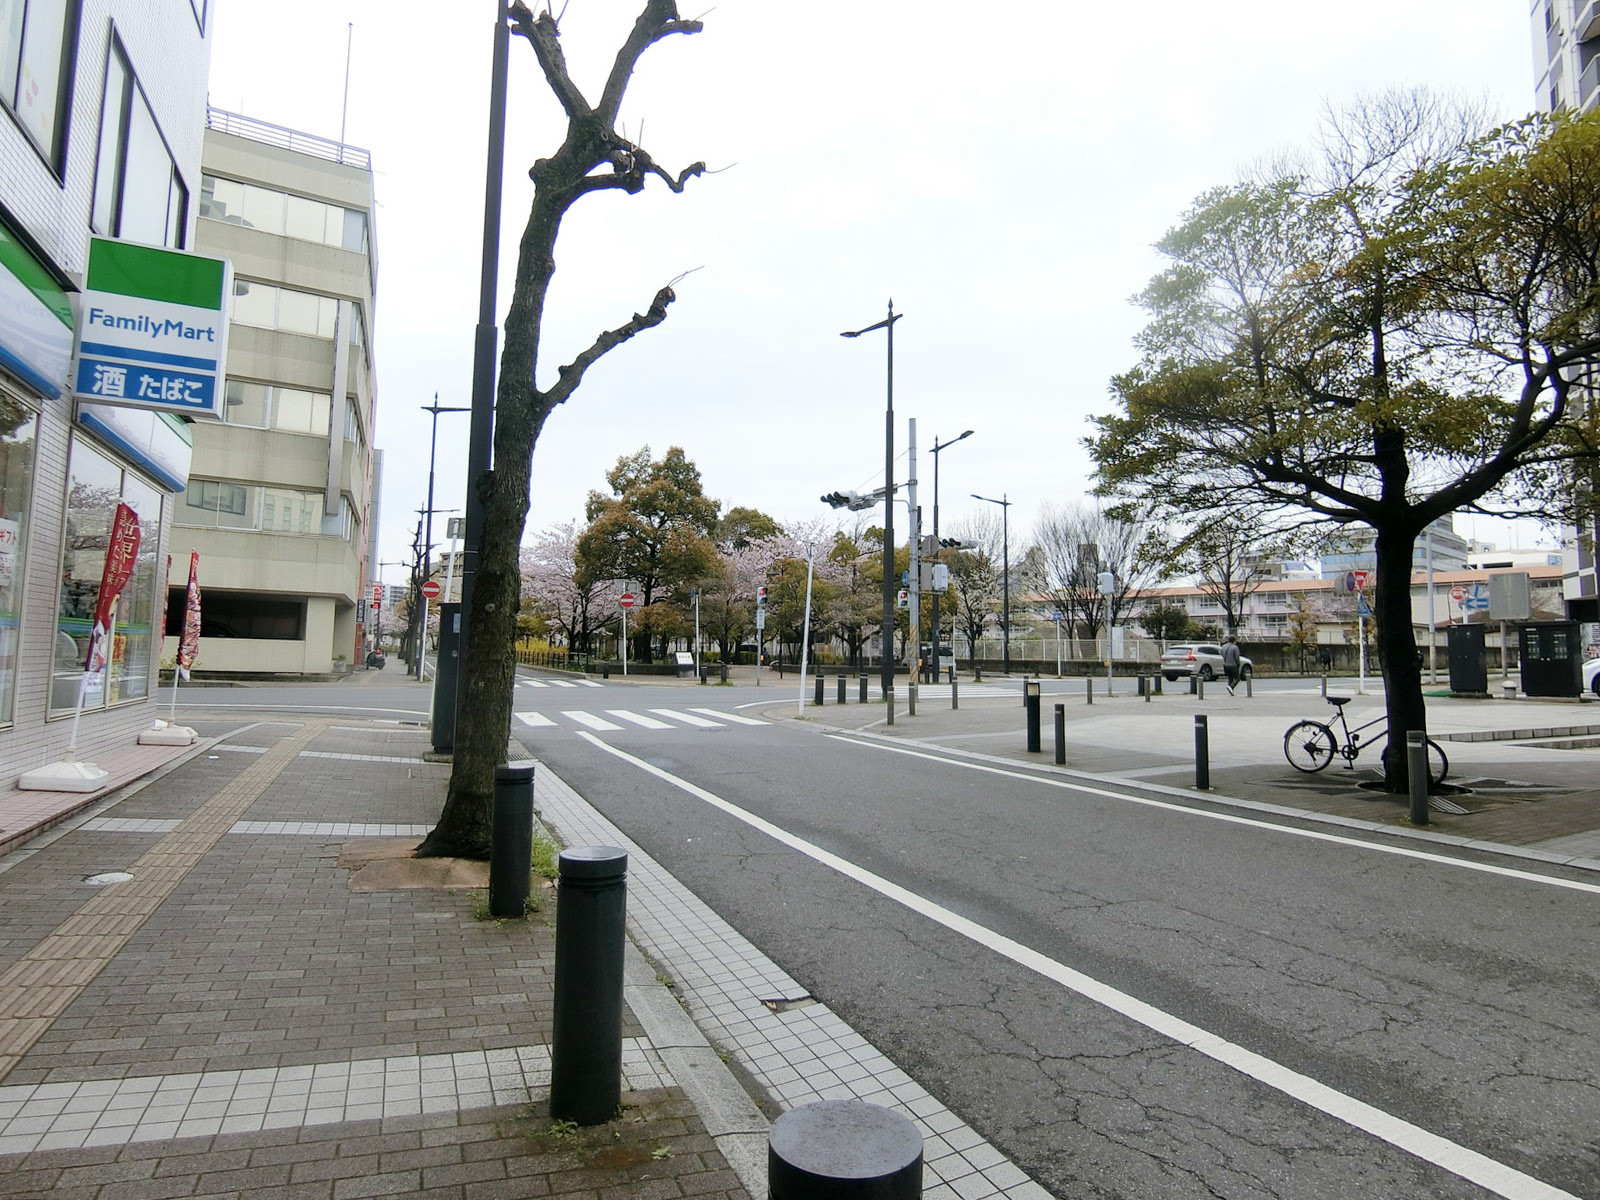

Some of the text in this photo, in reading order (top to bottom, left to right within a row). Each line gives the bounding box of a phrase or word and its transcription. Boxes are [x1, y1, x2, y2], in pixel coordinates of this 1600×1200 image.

[89, 307, 215, 342] FamilyMart
[92, 364, 203, 404] 酒 たばこ
